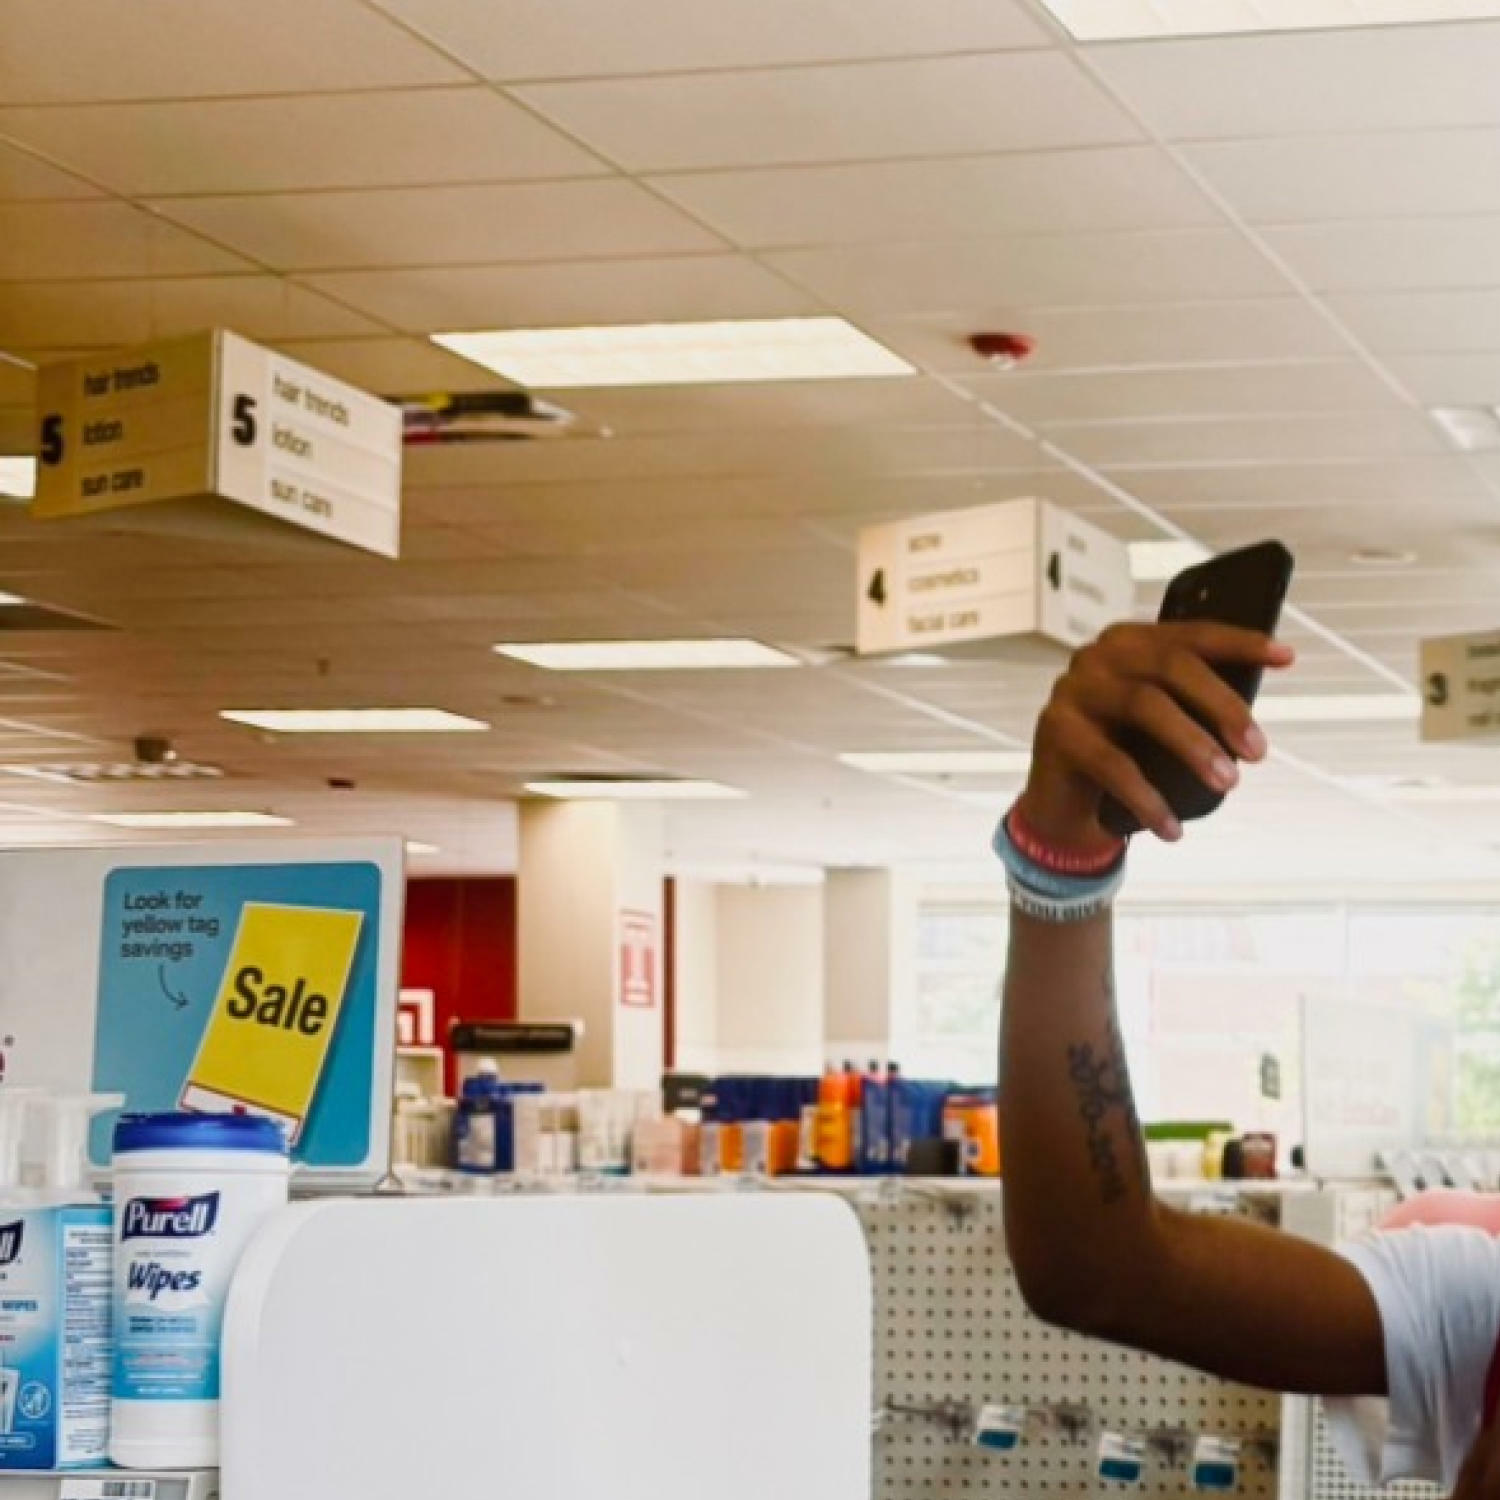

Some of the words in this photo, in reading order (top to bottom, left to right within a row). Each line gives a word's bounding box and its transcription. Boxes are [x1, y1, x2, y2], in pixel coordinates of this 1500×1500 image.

[232, 394, 258, 446] 5
[304, 385, 351, 428] trends
[40, 413, 63, 466] 5
[83, 420, 123, 446] lotion
[272, 427, 313, 459] lotion
[81, 474, 109, 498] sun
[112, 467, 144, 494] care
[271, 477, 299, 503] sun
[301, 489, 333, 519] care
[867, 567, 885, 608] 4
[1427, 671, 1449, 706] 3
[123, 891, 170, 911] Look
[173, 891, 204, 911] for
[121, 914, 185, 939] yellow
[187, 914, 220, 939] tag
[120, 939, 195, 962] savings
[226, 965, 328, 1037] Sale
[125, 1197, 211, 1235] Purell
[126, 1260, 203, 1301] Wipes
